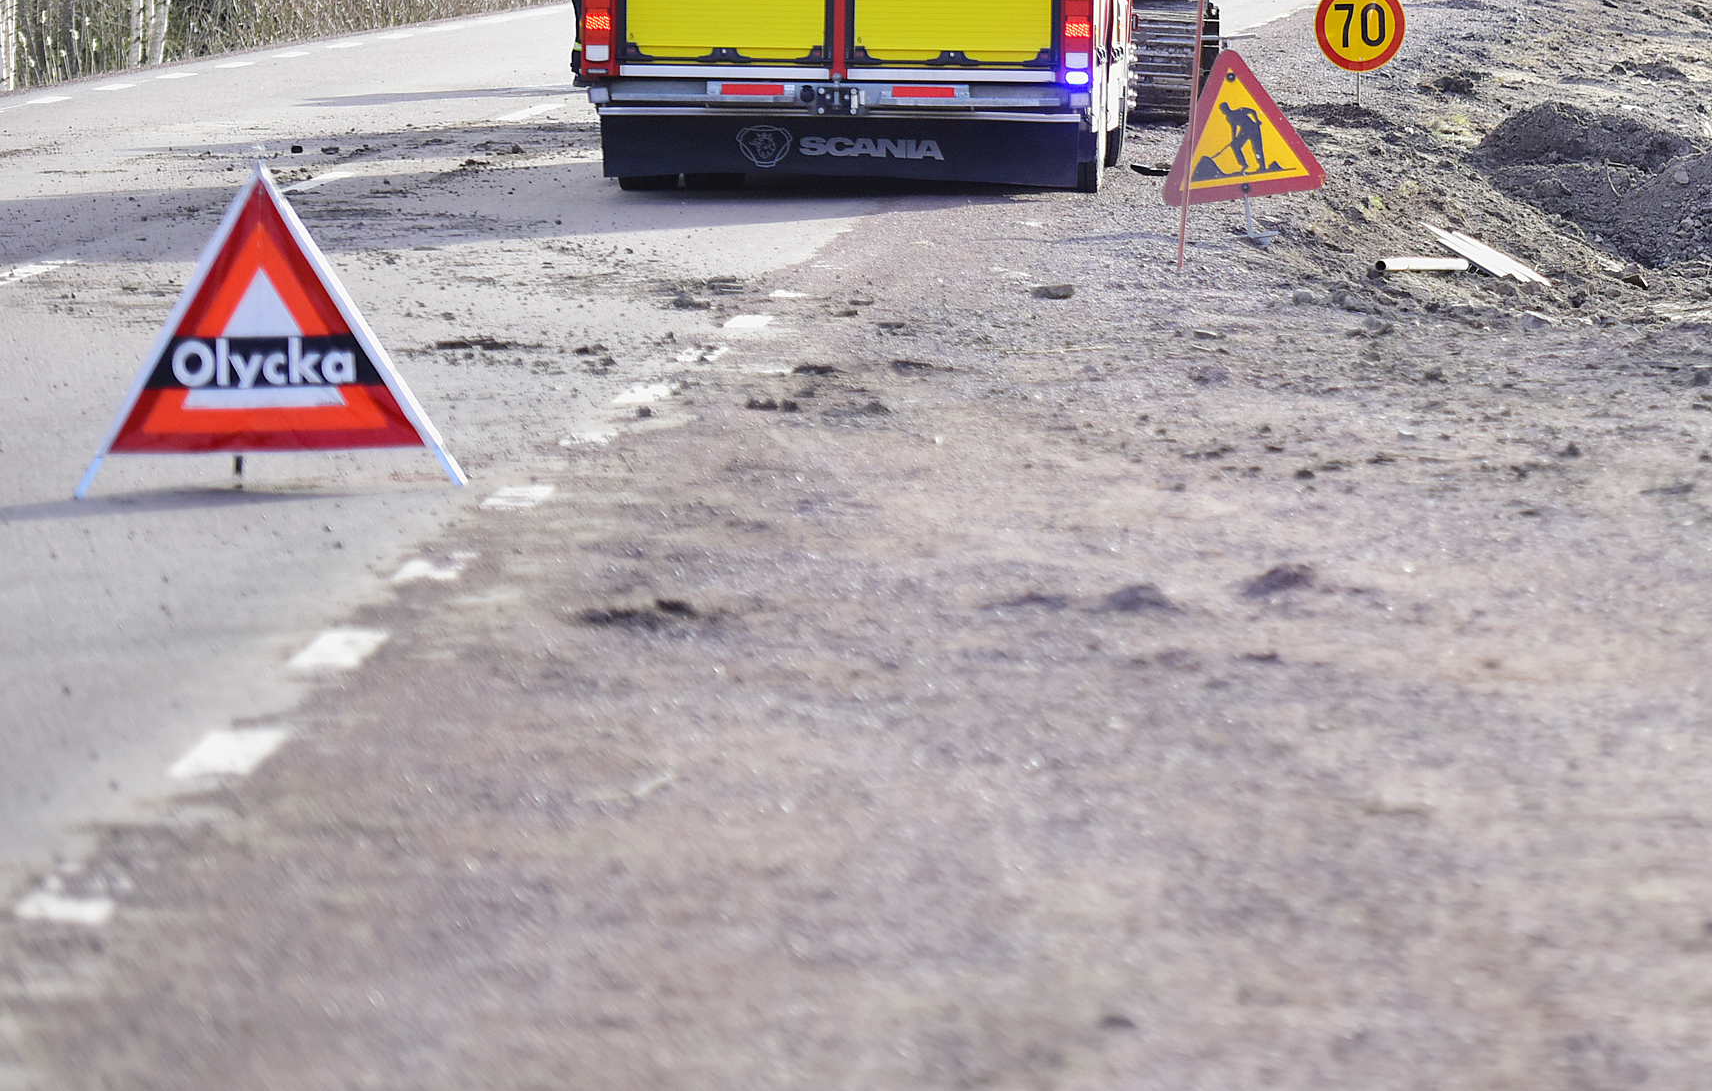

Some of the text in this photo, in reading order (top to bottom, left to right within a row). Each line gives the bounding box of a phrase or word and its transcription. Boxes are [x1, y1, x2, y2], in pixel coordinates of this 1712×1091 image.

[1334, 2, 1386, 48] 70
[799, 136, 945, 161] SCANIA
[171, 336, 358, 389] Olycka
